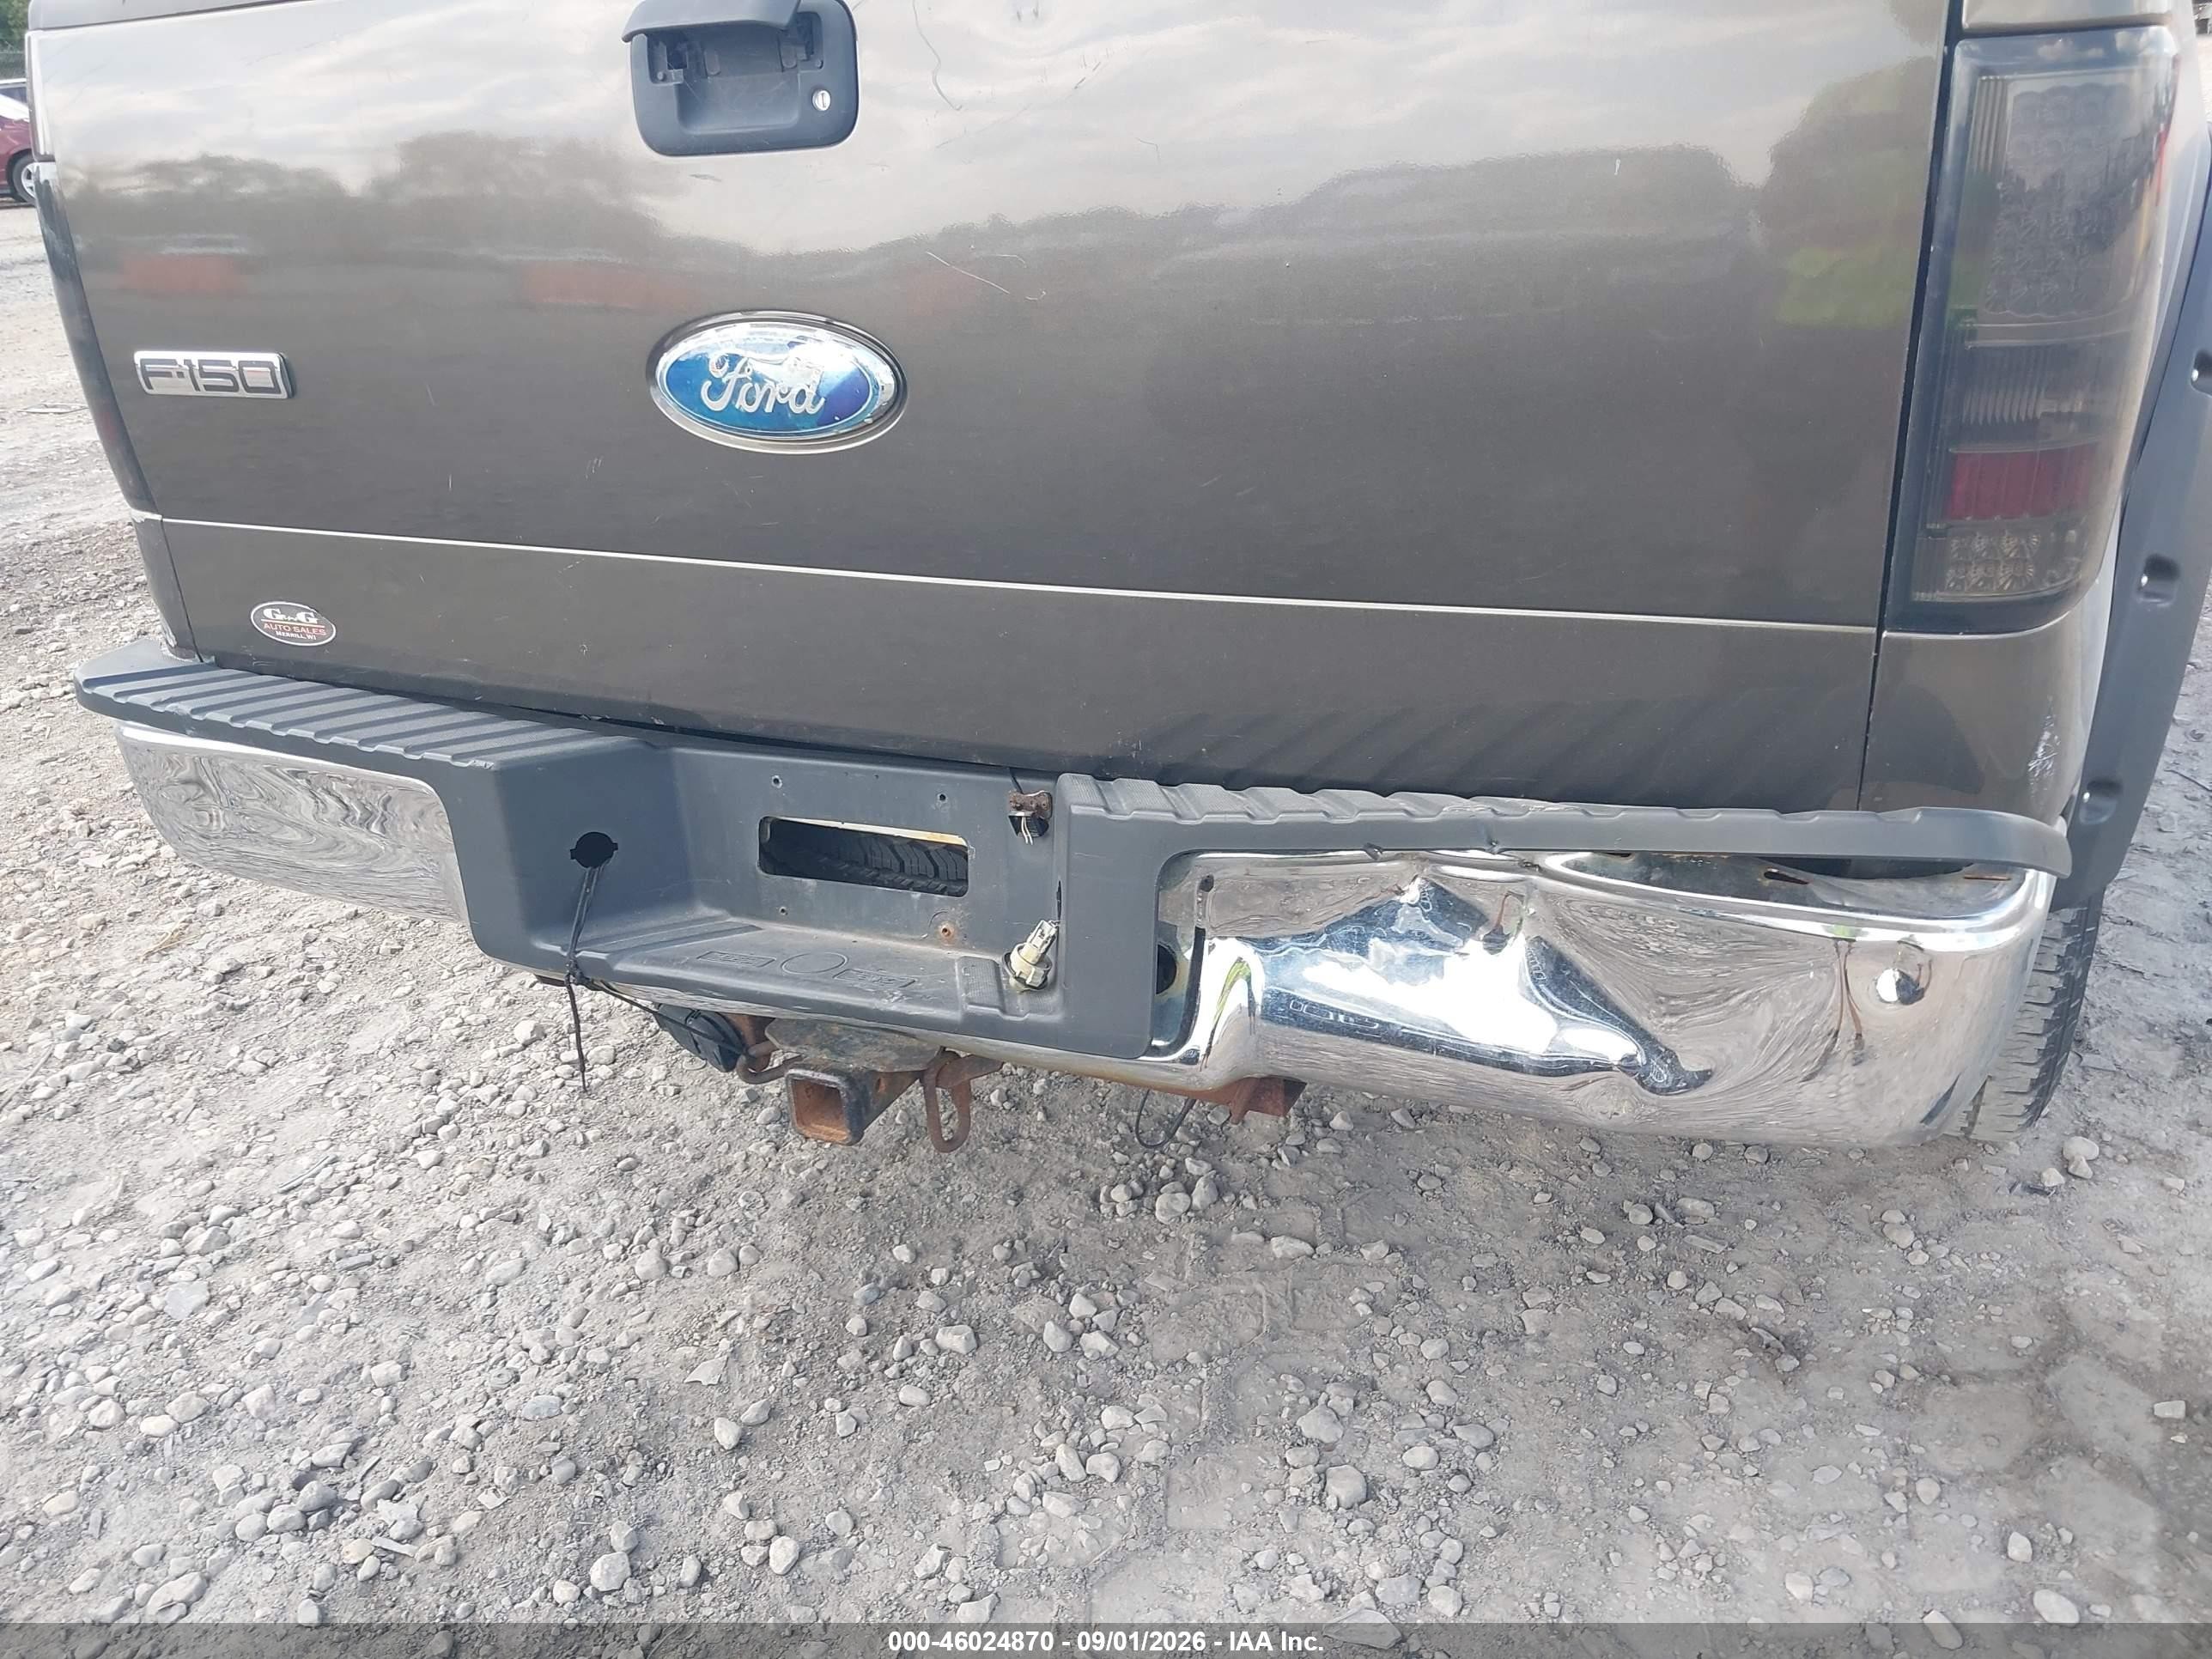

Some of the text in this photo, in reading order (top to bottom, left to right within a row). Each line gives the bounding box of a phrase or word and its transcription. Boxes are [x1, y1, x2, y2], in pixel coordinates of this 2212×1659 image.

[140, 358, 282, 394] F-150
[700, 351, 825, 414] Ford
[264, 623, 327, 635] AUTO SALES
